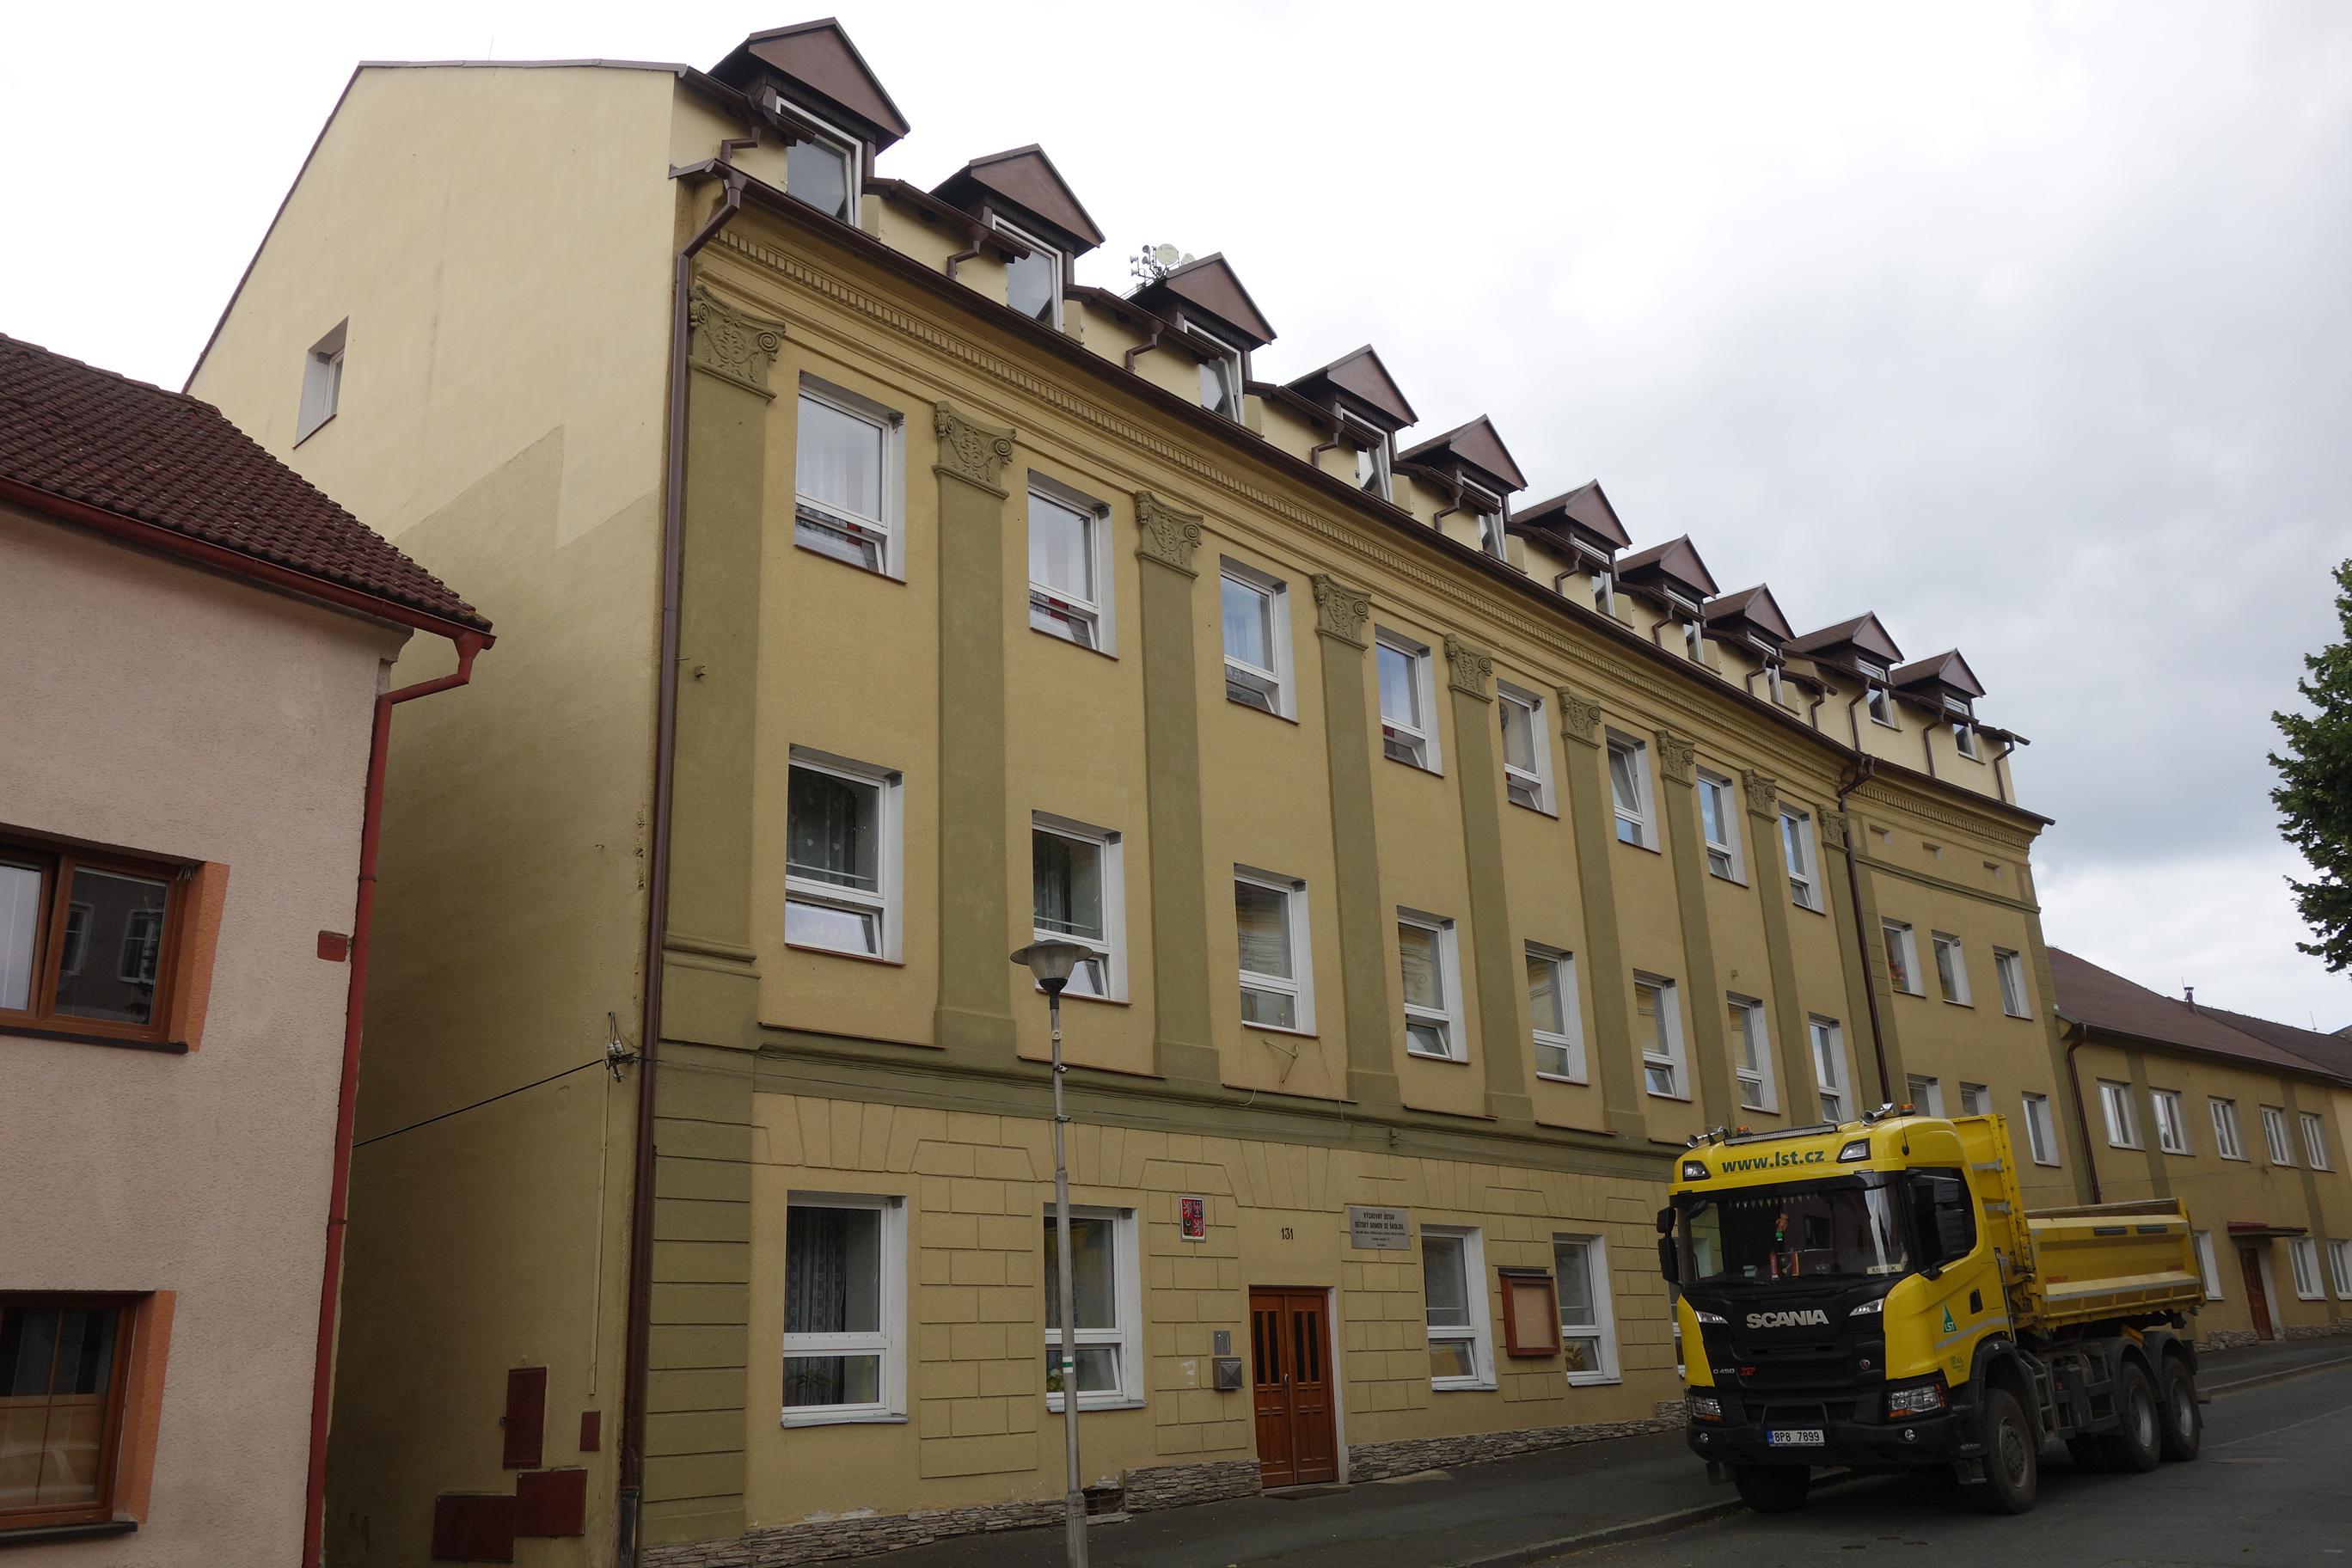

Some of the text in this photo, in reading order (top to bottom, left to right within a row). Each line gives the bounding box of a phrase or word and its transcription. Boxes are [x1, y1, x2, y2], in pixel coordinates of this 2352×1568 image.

[1722, 1150, 1825, 1173] www.lst.cz
[1281, 1227, 1294, 1240] 131
[1746, 1309, 1829, 1329] SCANIA
[1945, 1321, 1956, 1332] LST
[1774, 1431, 1792, 1442] 8P8
[1797, 1430, 1820, 1442] 7899
